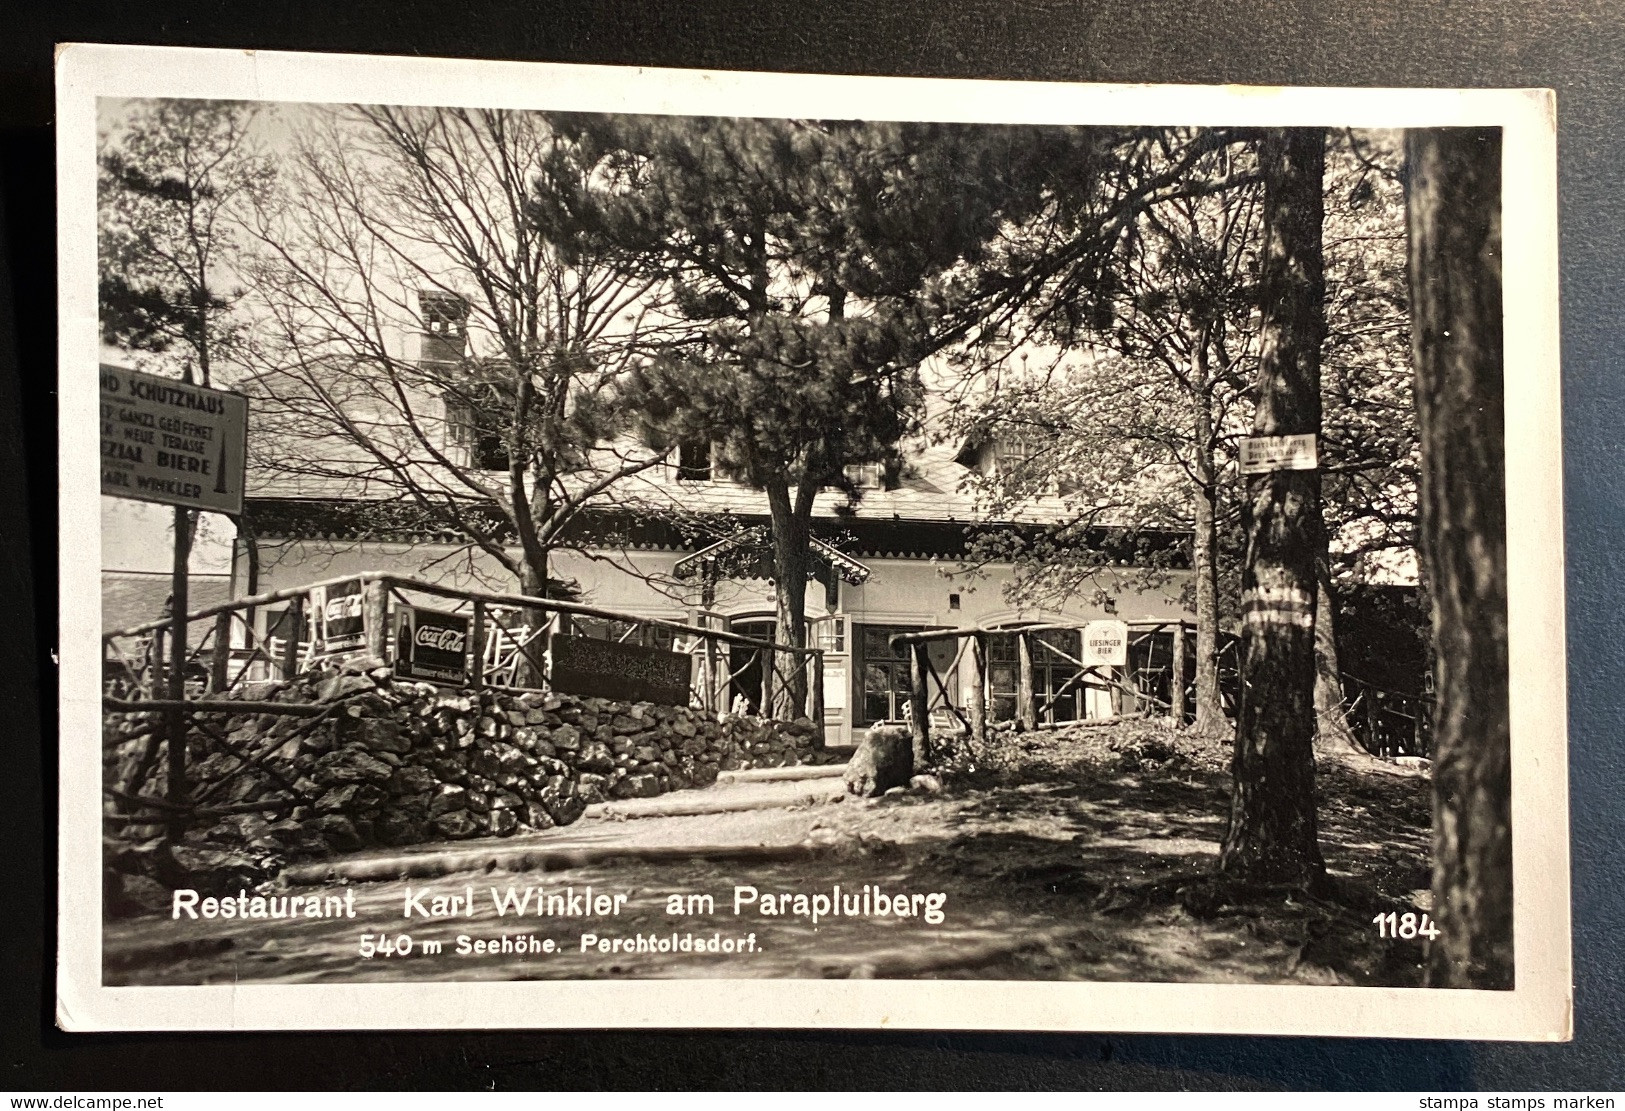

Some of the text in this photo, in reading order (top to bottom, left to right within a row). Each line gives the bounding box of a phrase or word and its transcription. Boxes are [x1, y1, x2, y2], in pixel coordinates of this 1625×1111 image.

[129, 380, 224, 414] SCHUTZHAUS
[124, 427, 155, 445] NEUE
[157, 450, 211, 476] BIERE
[136, 475, 202, 499] WINKLER
[1090, 639, 1121, 647] LIESINGER
